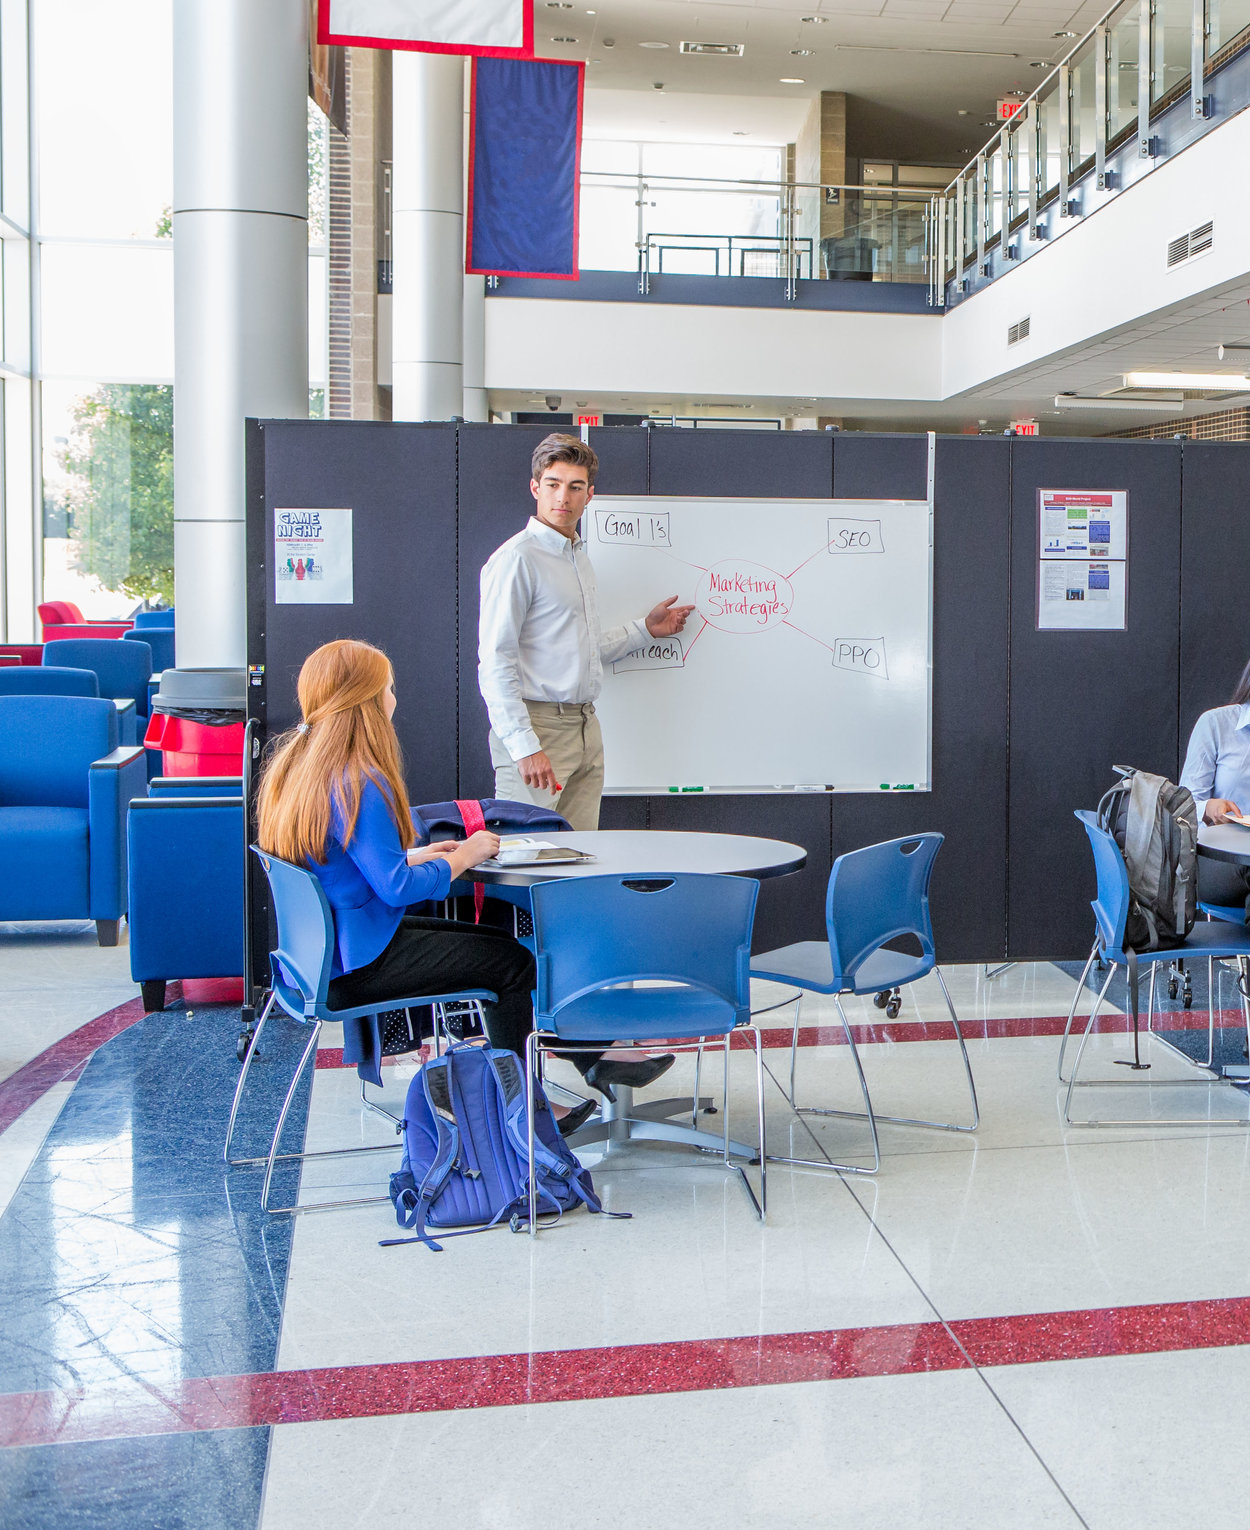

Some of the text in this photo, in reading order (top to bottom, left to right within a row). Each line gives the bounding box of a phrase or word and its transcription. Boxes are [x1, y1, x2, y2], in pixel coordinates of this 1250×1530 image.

[578, 416, 599, 427] EXIT
[279, 512, 320, 524] GAME
[605, 514, 640, 539] Goal
[277, 525, 322, 537] NIGHT
[835, 529, 871, 548] SEO
[709, 572, 777, 603] Marketing
[708, 595, 789, 624] Strategies
[838, 643, 880, 668] PPO
